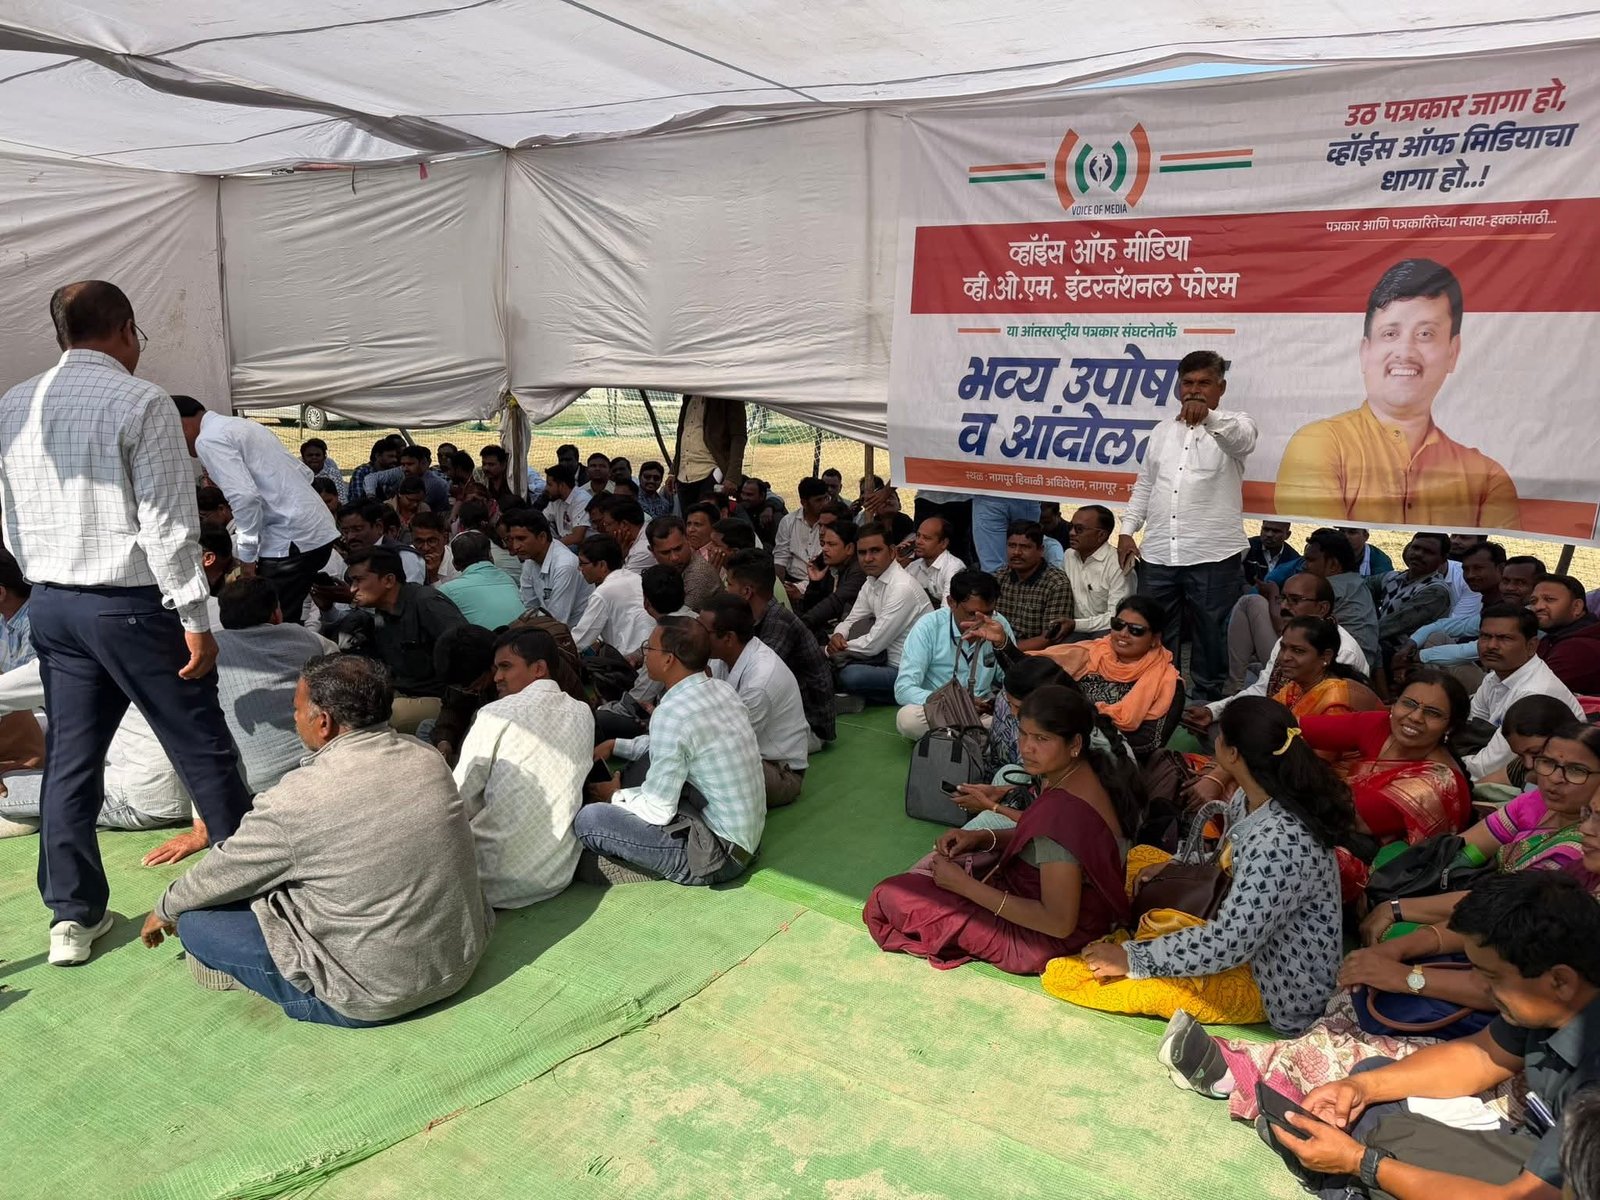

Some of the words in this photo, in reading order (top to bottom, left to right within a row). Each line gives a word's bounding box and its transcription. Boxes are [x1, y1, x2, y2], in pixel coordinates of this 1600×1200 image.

[1344, 102, 1381, 127] उठ
[1383, 94, 1467, 123] पत्रकार
[1467, 88, 1532, 116] जागा
[1532, 77, 1567, 114] हो,
[1398, 126, 1459, 158] ऑफ
[1460, 120, 1579, 154] मिडियाचा
[1380, 165, 1438, 192] धागा
[1071, 204, 1092, 216] VOICE
[1093, 204, 1103, 215] OF
[1104, 202, 1128, 214] MEDIA
[1326, 221, 1360, 232] पत्रकार
[1362, 216, 1389, 231] आणि
[1392, 214, 1456, 230] पत्रकारितेच्या
[1070, 232, 1116, 264] ऑफ
[1123, 228, 1192, 262] मीडिया
[962, 271, 1057, 301] व्ही.ओ.एम.
[1064, 266, 1174, 300] इंटरनॅशनल
[1177, 265, 1241, 299] फोरम
[1006, 326, 1018, 337] या
[1082, 326, 1120, 338] पत्रकार
[1121, 322, 1178, 338] संघटनेतर्फे
[957, 356, 1062, 403] भव्य
[1062, 343, 1181, 407] उपोष
[958, 413, 999, 456] व
[988, 473, 1014, 486] नागपूर
[1089, 481, 1117, 495] नागपूर
